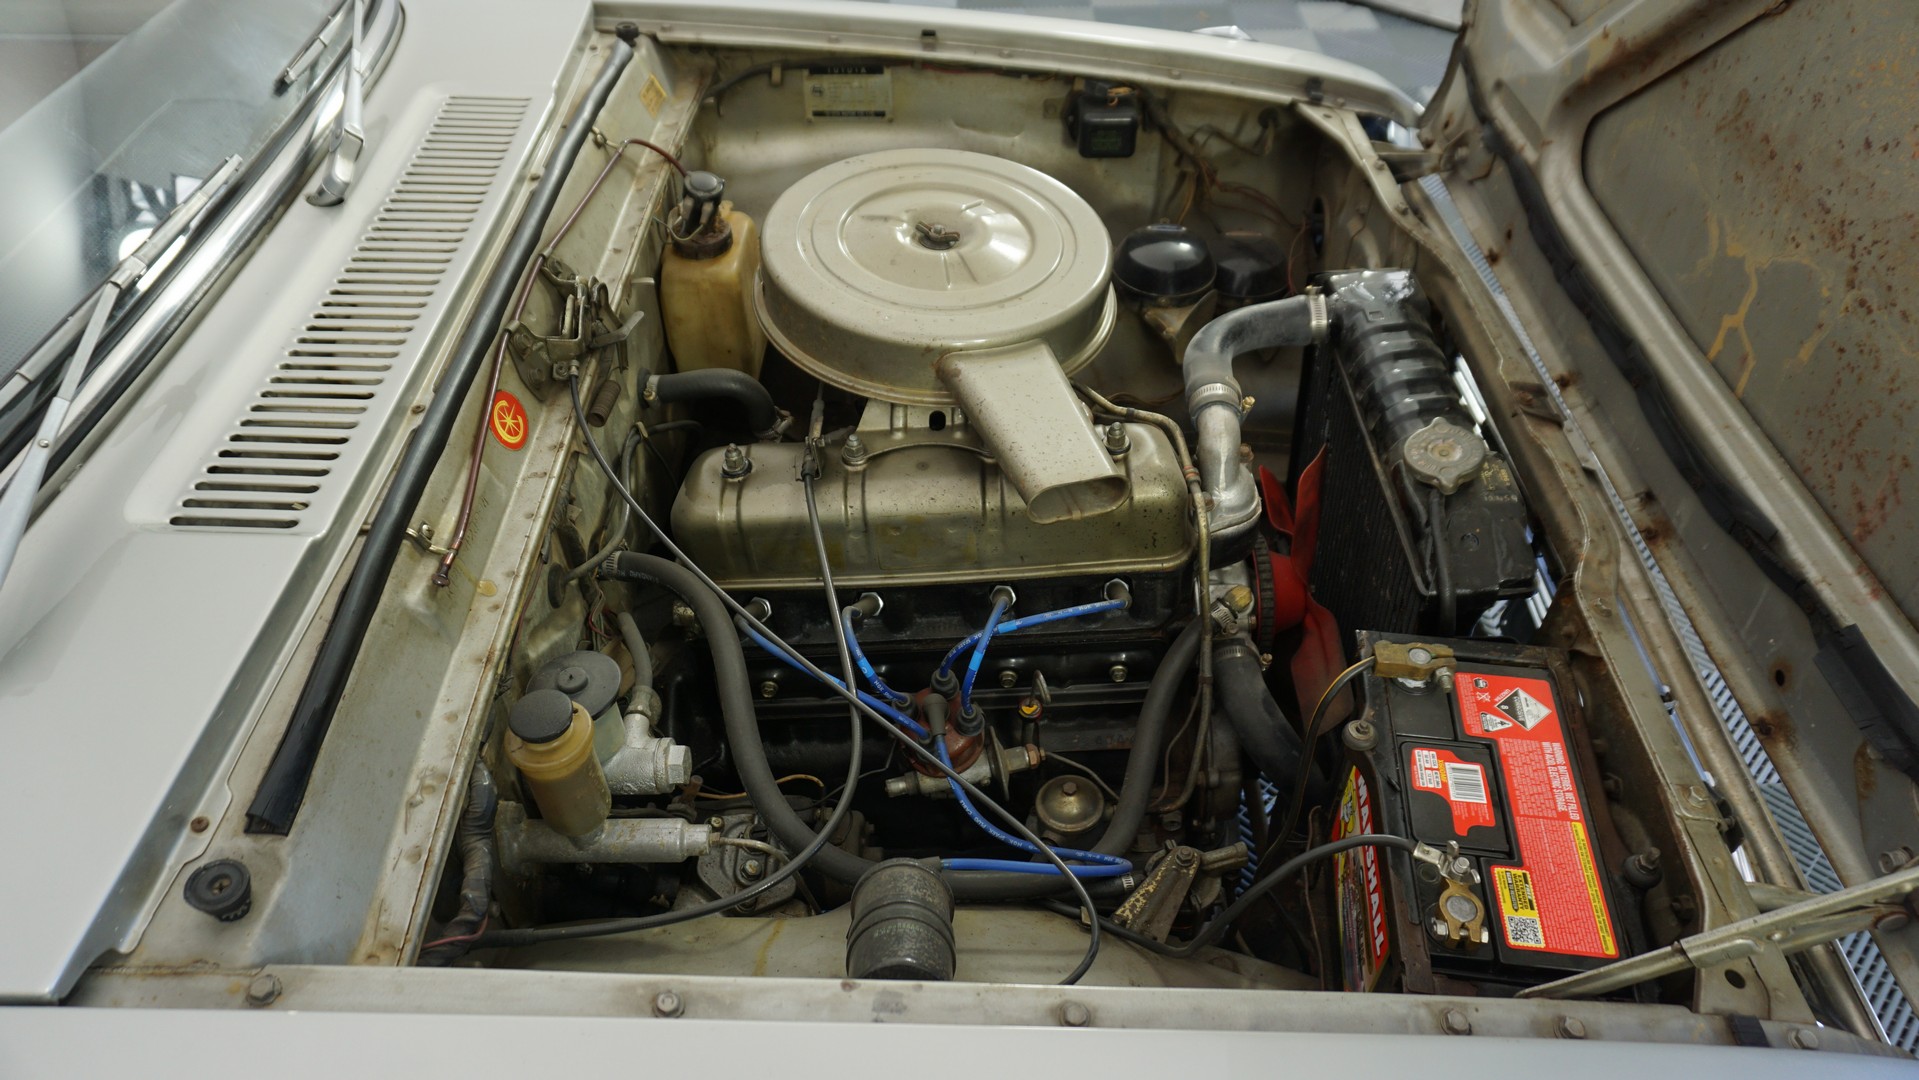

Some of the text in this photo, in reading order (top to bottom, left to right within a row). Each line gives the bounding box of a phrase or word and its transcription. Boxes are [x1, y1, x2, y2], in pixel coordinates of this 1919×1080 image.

[1541, 741, 1554, 754] WITH
[1547, 766, 1561, 789] ELECTRIC
[1565, 791, 1577, 803] WET
[1567, 803, 1581, 820] FILLED
[973, 816, 987, 829] PLUG
[987, 827, 1006, 841] SPARK
[1513, 873, 1524, 911] WARRANTY
[1517, 874, 1529, 910] EXTENDED
